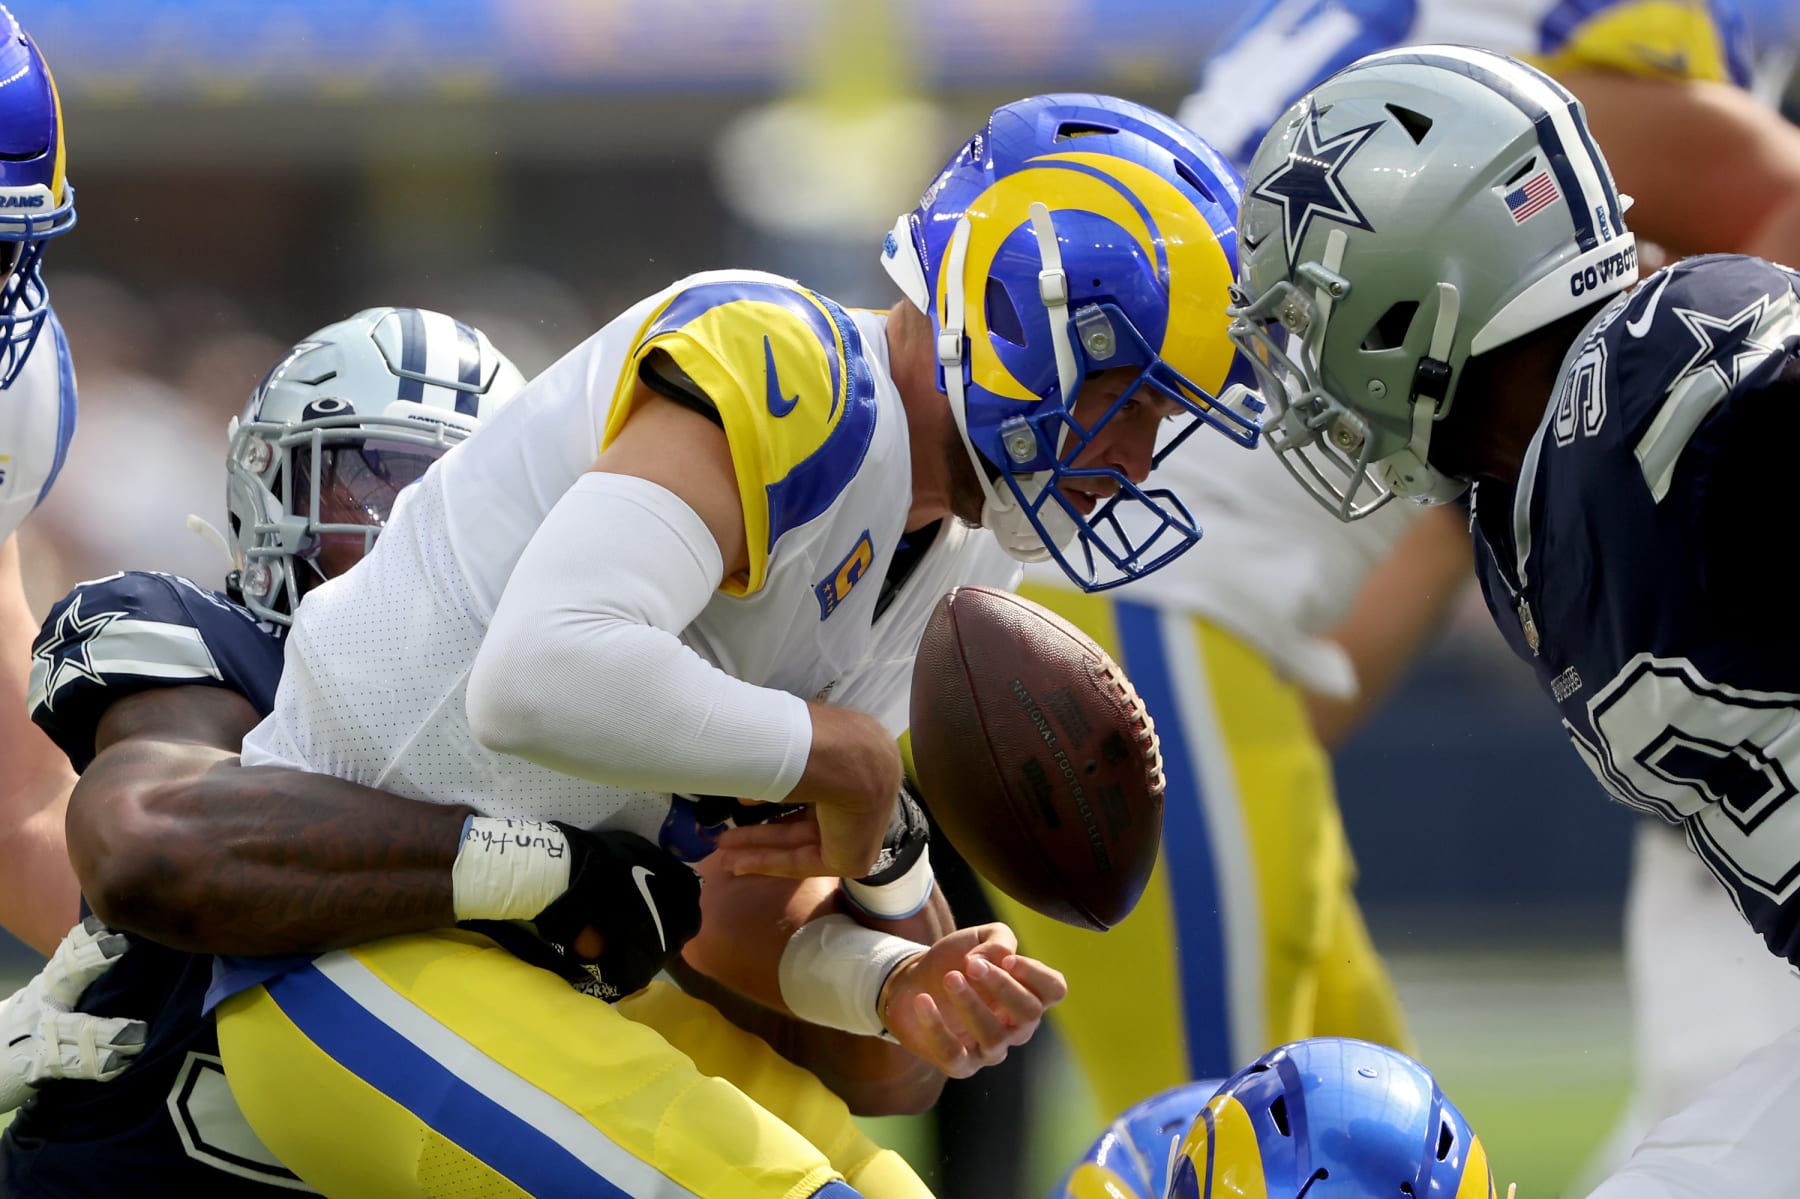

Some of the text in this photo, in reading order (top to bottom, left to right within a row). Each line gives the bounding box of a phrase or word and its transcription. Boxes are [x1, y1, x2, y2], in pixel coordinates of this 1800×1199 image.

[1570, 244, 1638, 297] COWBOY
[1010, 678, 1057, 748] NATIONAL
[1054, 749, 1094, 822] FOOTBALL
[514, 833, 565, 859] Run
